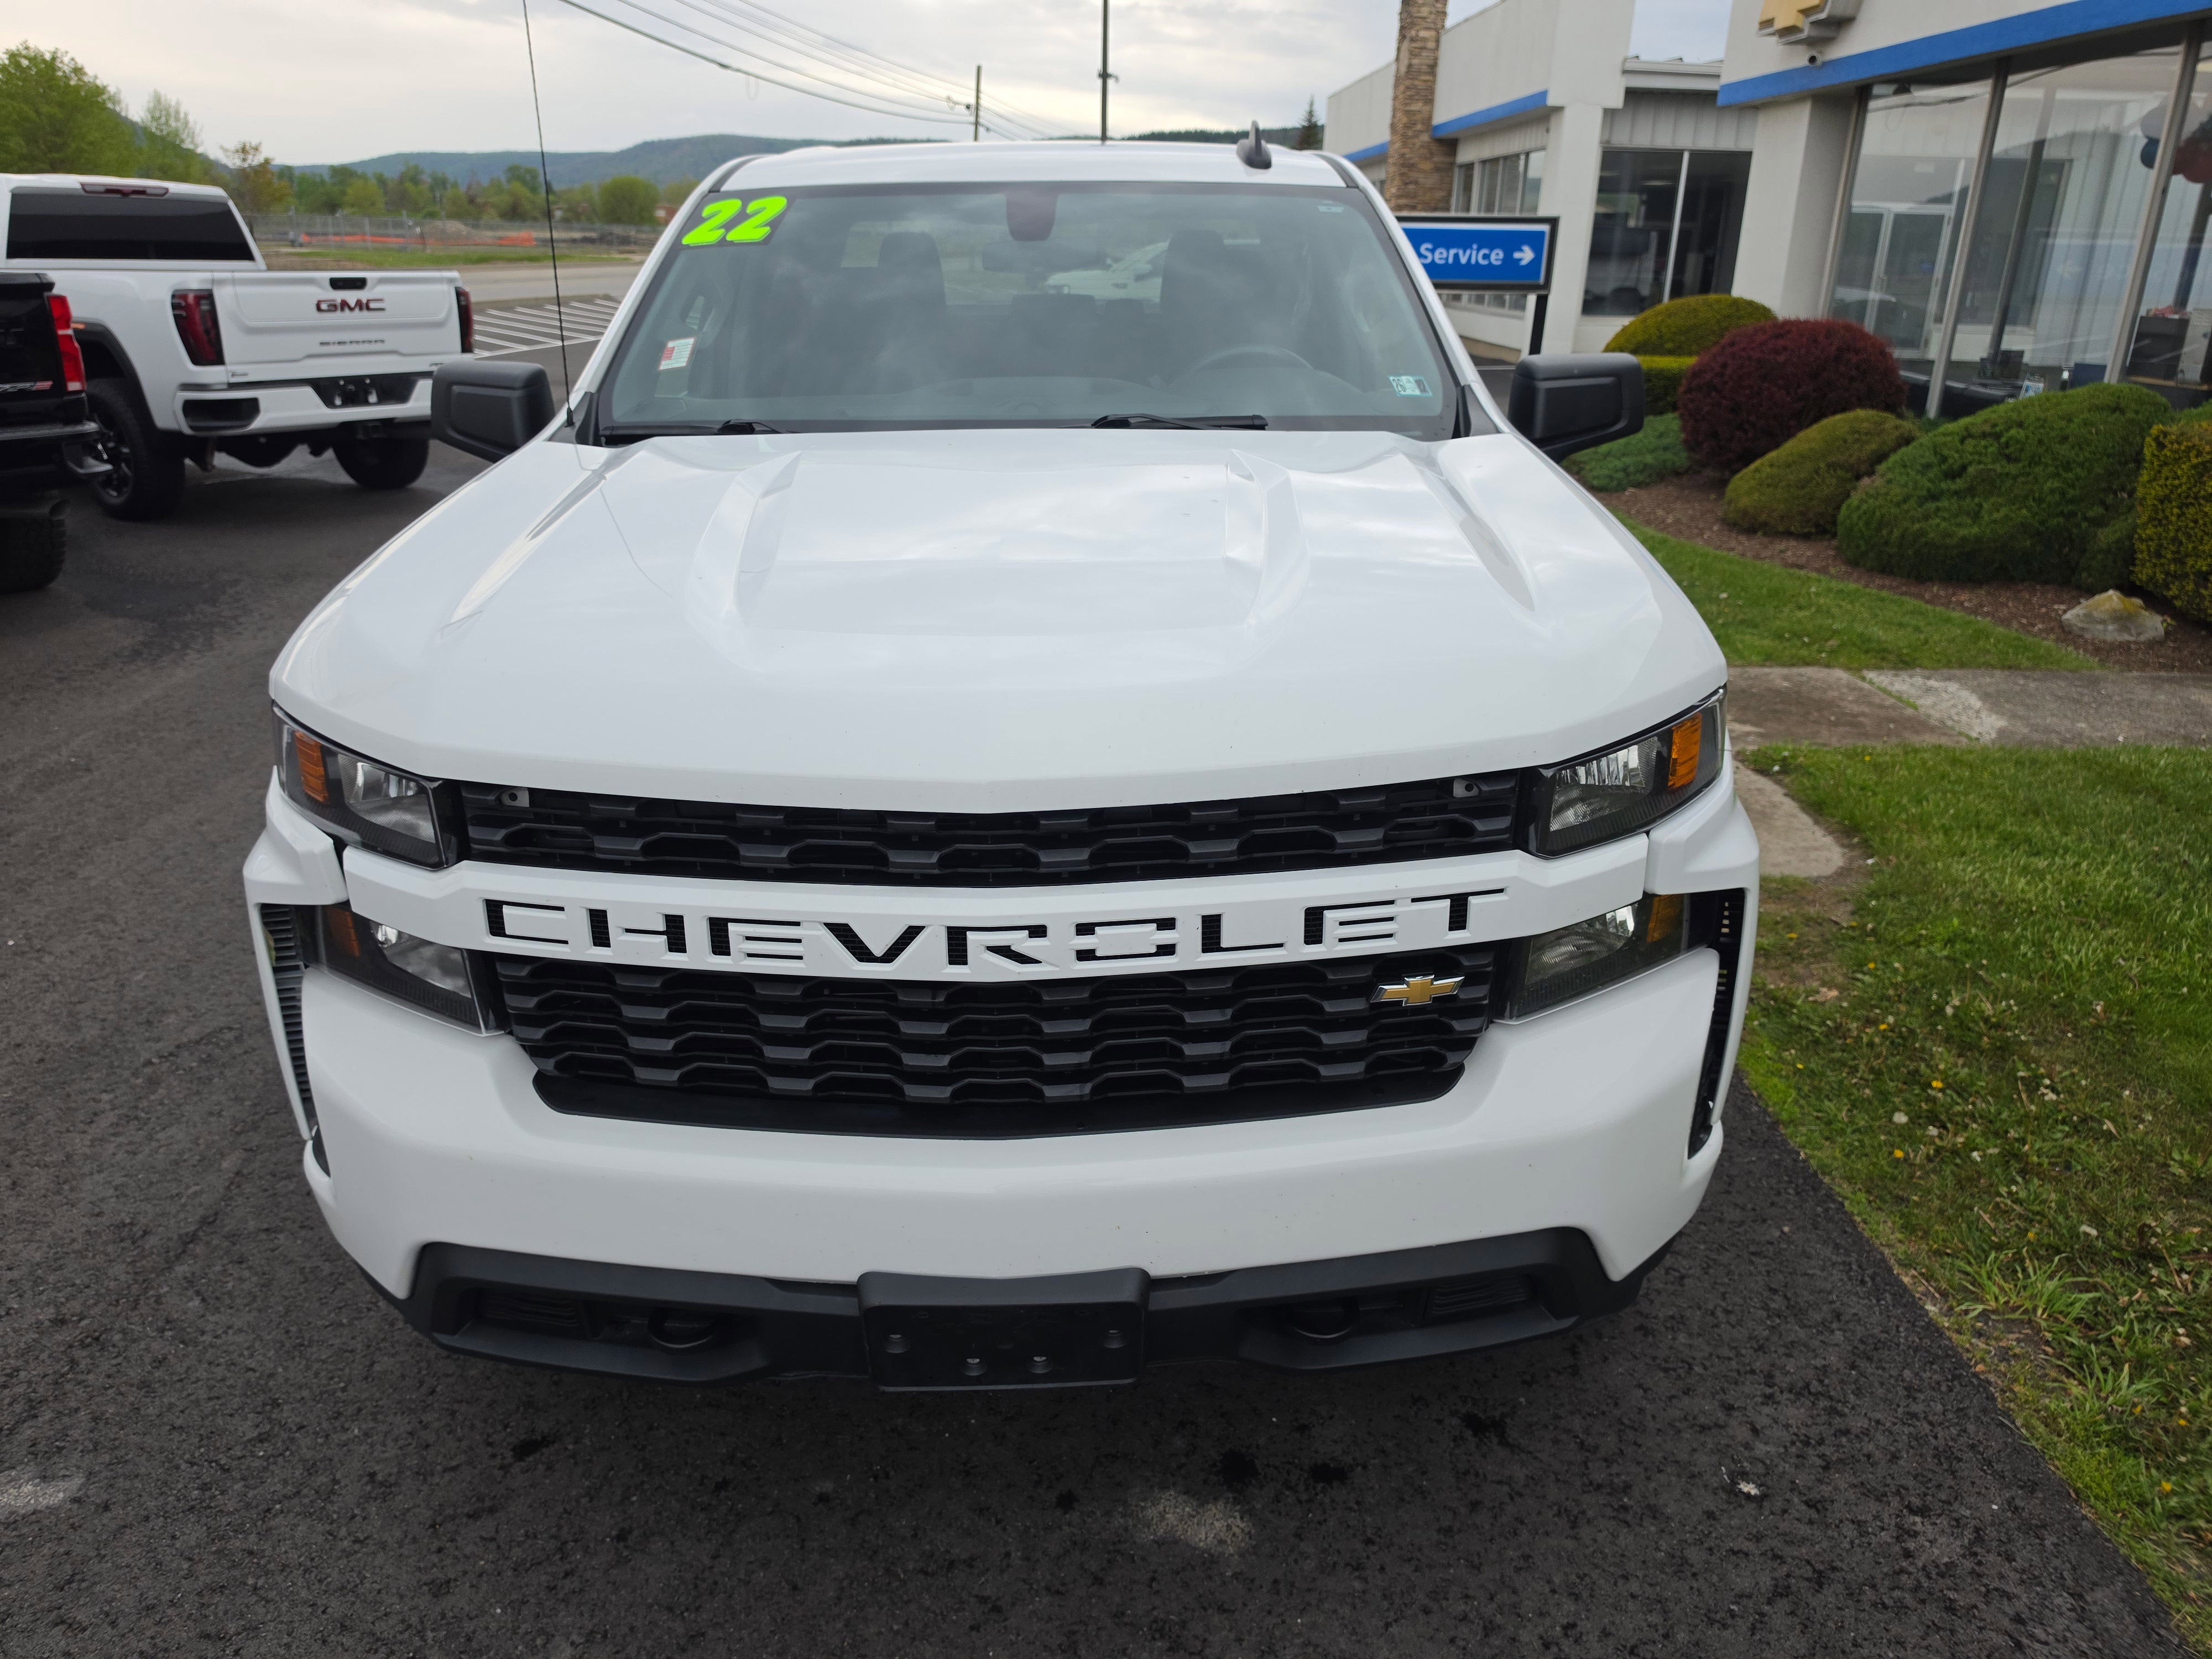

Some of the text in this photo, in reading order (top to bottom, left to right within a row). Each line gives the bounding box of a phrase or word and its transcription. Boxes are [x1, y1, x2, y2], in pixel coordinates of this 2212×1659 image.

[681, 196, 787, 246] 22
[1419, 242, 1504, 265] Service
[316, 298, 385, 312] GMC
[482, 887, 1505, 966] CHEVROLET
